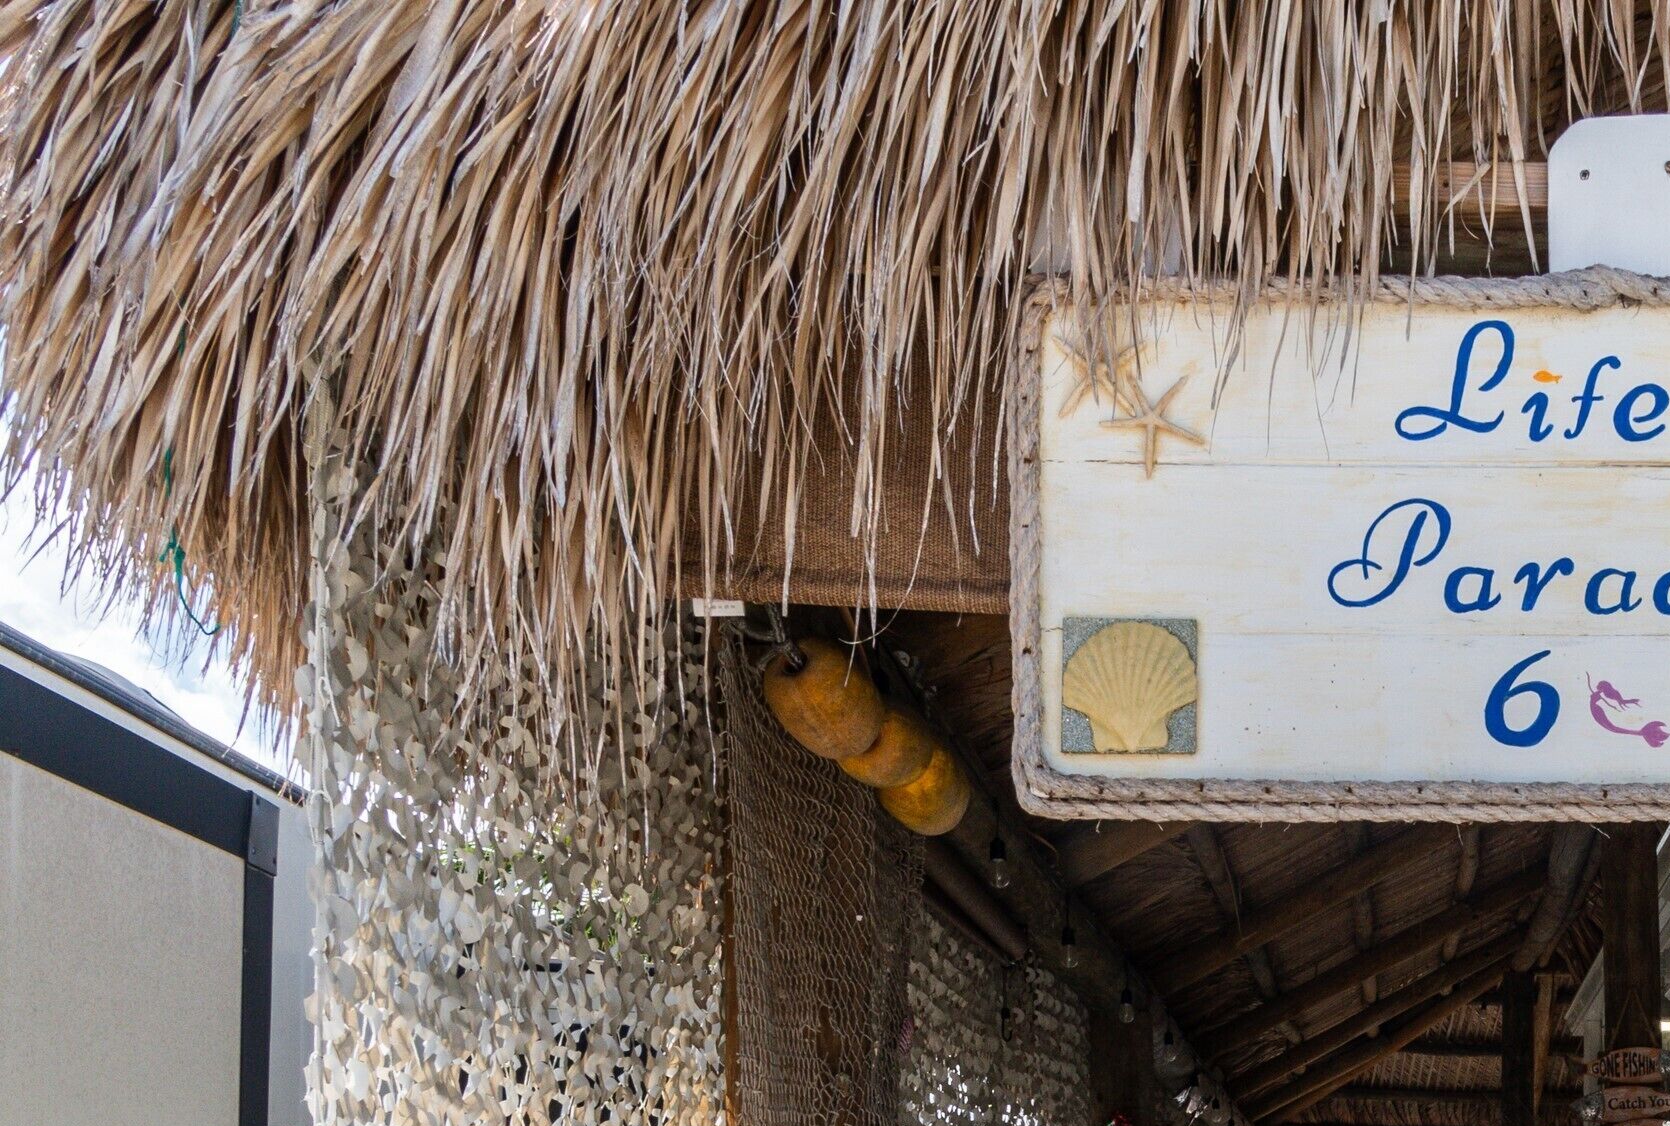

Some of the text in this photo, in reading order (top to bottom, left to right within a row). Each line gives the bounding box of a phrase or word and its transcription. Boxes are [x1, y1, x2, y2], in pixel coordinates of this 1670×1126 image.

[1394, 319, 1670, 444] Life
[1483, 648, 1562, 749] 6
[1592, 1052, 1621, 1078] GONE
[1607, 1096, 1647, 1111] Catch
